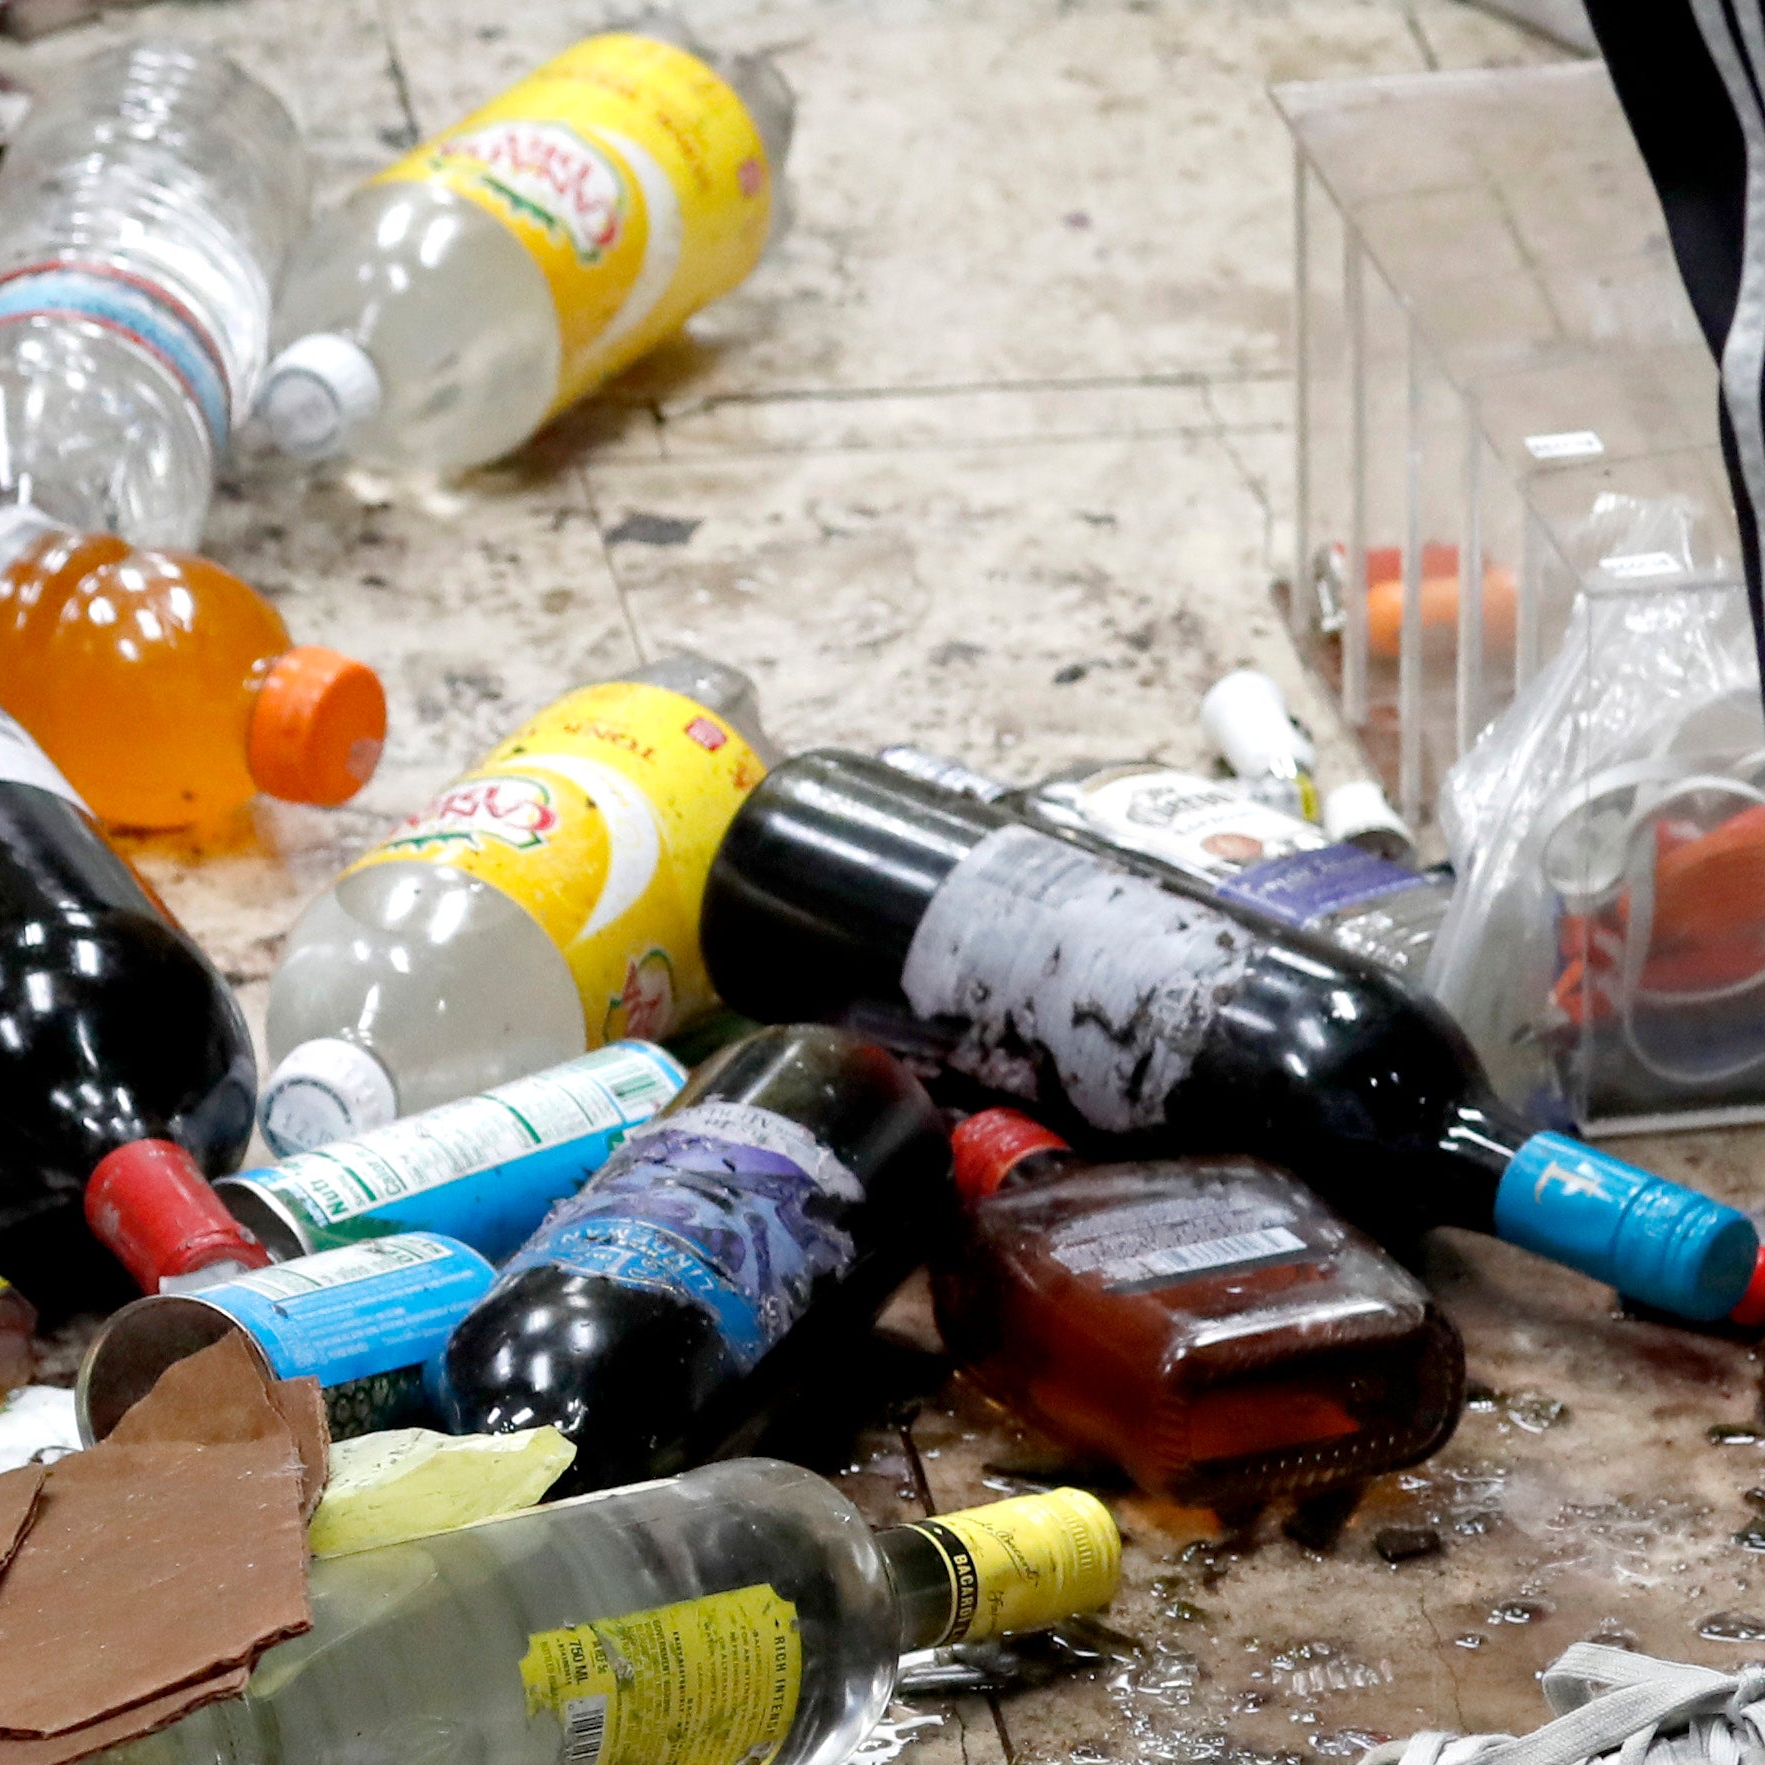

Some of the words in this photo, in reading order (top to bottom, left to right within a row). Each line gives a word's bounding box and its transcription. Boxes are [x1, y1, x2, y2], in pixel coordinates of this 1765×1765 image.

[567, 1638, 585, 1664] 750
[772, 1635, 789, 1672] RICH
[571, 1663, 590, 1685] ML
